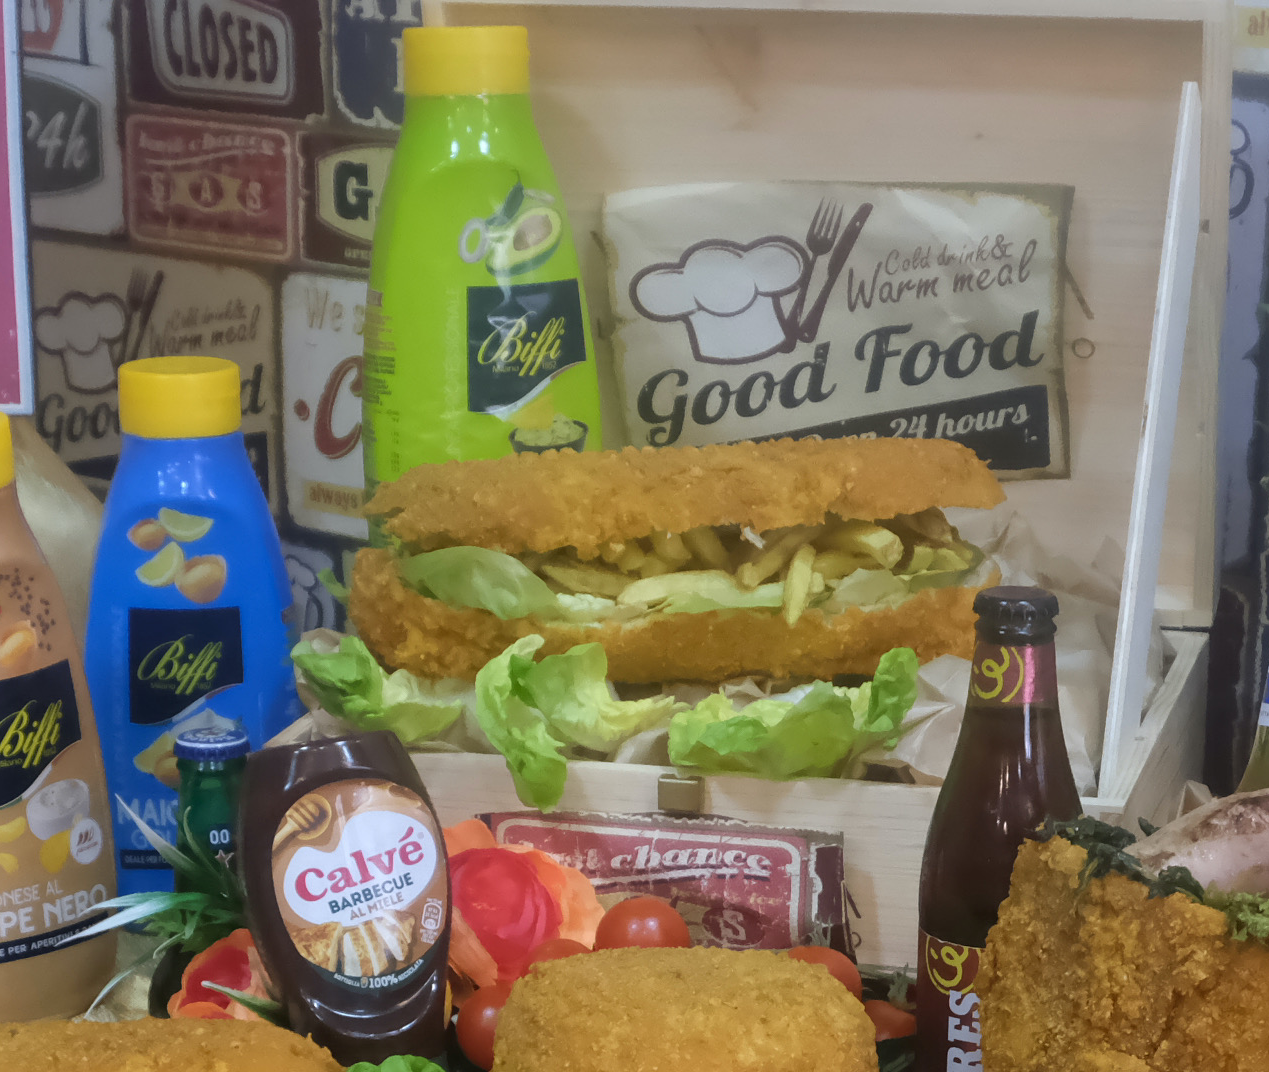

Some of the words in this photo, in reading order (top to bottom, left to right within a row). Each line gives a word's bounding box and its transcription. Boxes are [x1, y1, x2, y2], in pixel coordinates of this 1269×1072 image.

[884, 250, 932, 276] Cold
[937, 234, 1015, 267] drink&
[847, 262, 939, 314] Warm
[953, 240, 1038, 288] meal
[477, 311, 566, 377] Biffi
[636, 342, 837, 448] Good
[854, 309, 1045, 394] Food
[35, 394, 120, 454] Goo
[890, 414, 928, 439] 24
[935, 403, 1031, 440] hours
[136, 633, 224, 695] Biffi
[294, 825, 426, 903] Calvé
[610, 844, 773, 878] chance
[42, 883, 108, 929] NERO
[46, 878, 64, 897] AL
[327, 871, 414, 916] BARBECUE
[349, 906, 368, 922] AL
[368, 890, 405, 915] MIELE
[719, 907, 746, 944] S
[8, 943, 28, 956] PER
[368, 973, 399, 989] 100%
